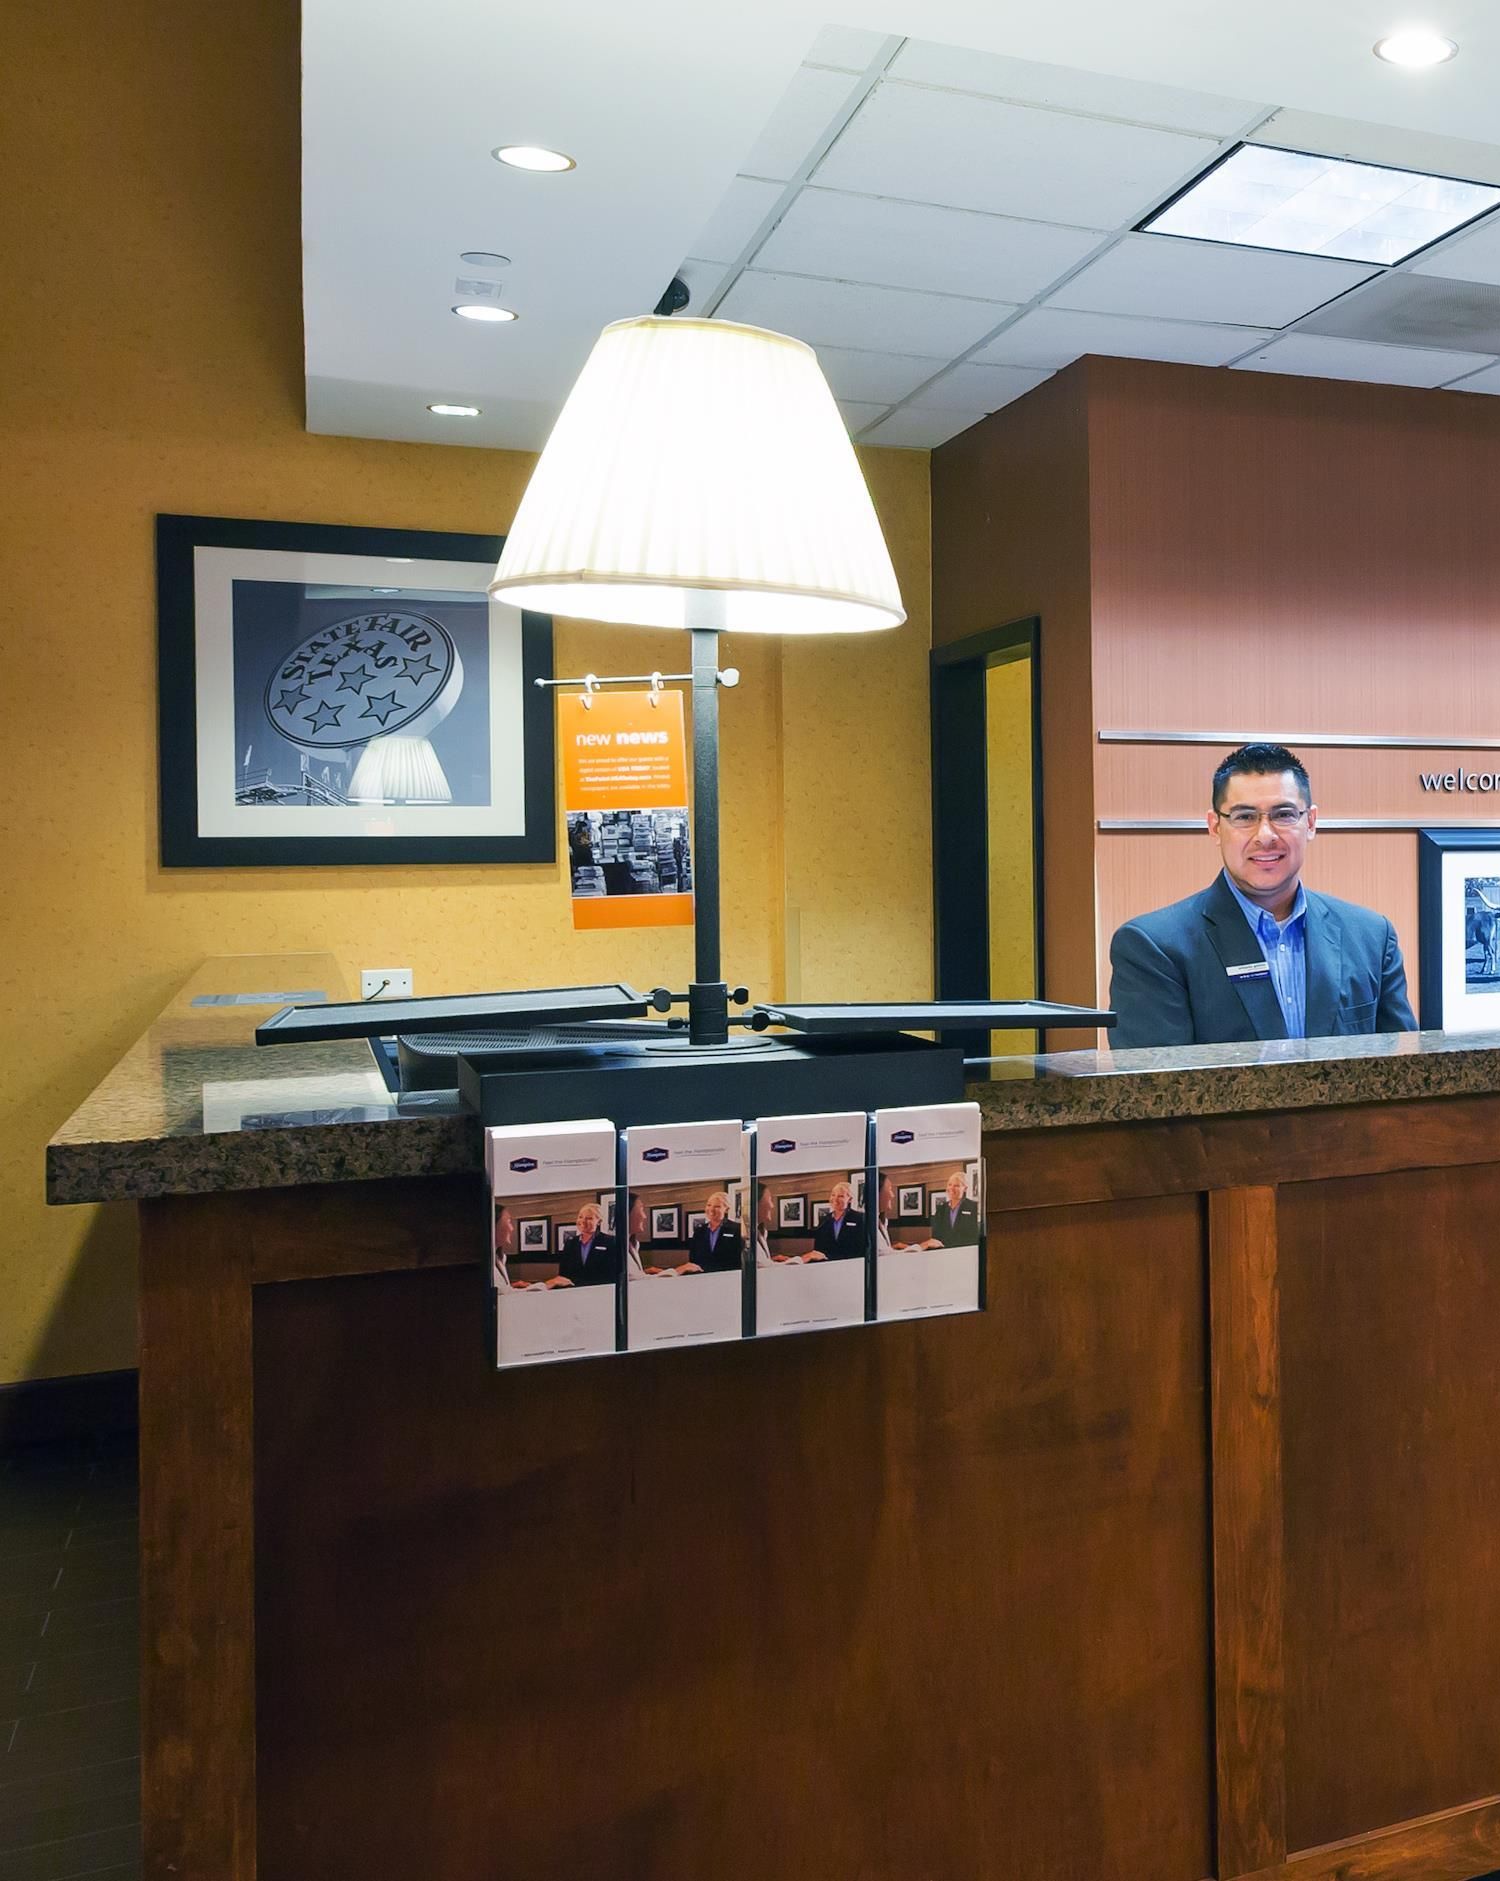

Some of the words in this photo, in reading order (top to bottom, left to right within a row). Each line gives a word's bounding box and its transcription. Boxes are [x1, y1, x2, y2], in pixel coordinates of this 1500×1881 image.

[281, 620, 361, 680] STATE
[364, 613, 432, 652] FAIR
[305, 634, 398, 685] TEXAS
[576, 733, 611, 746] new
[616, 732, 669, 745] news
